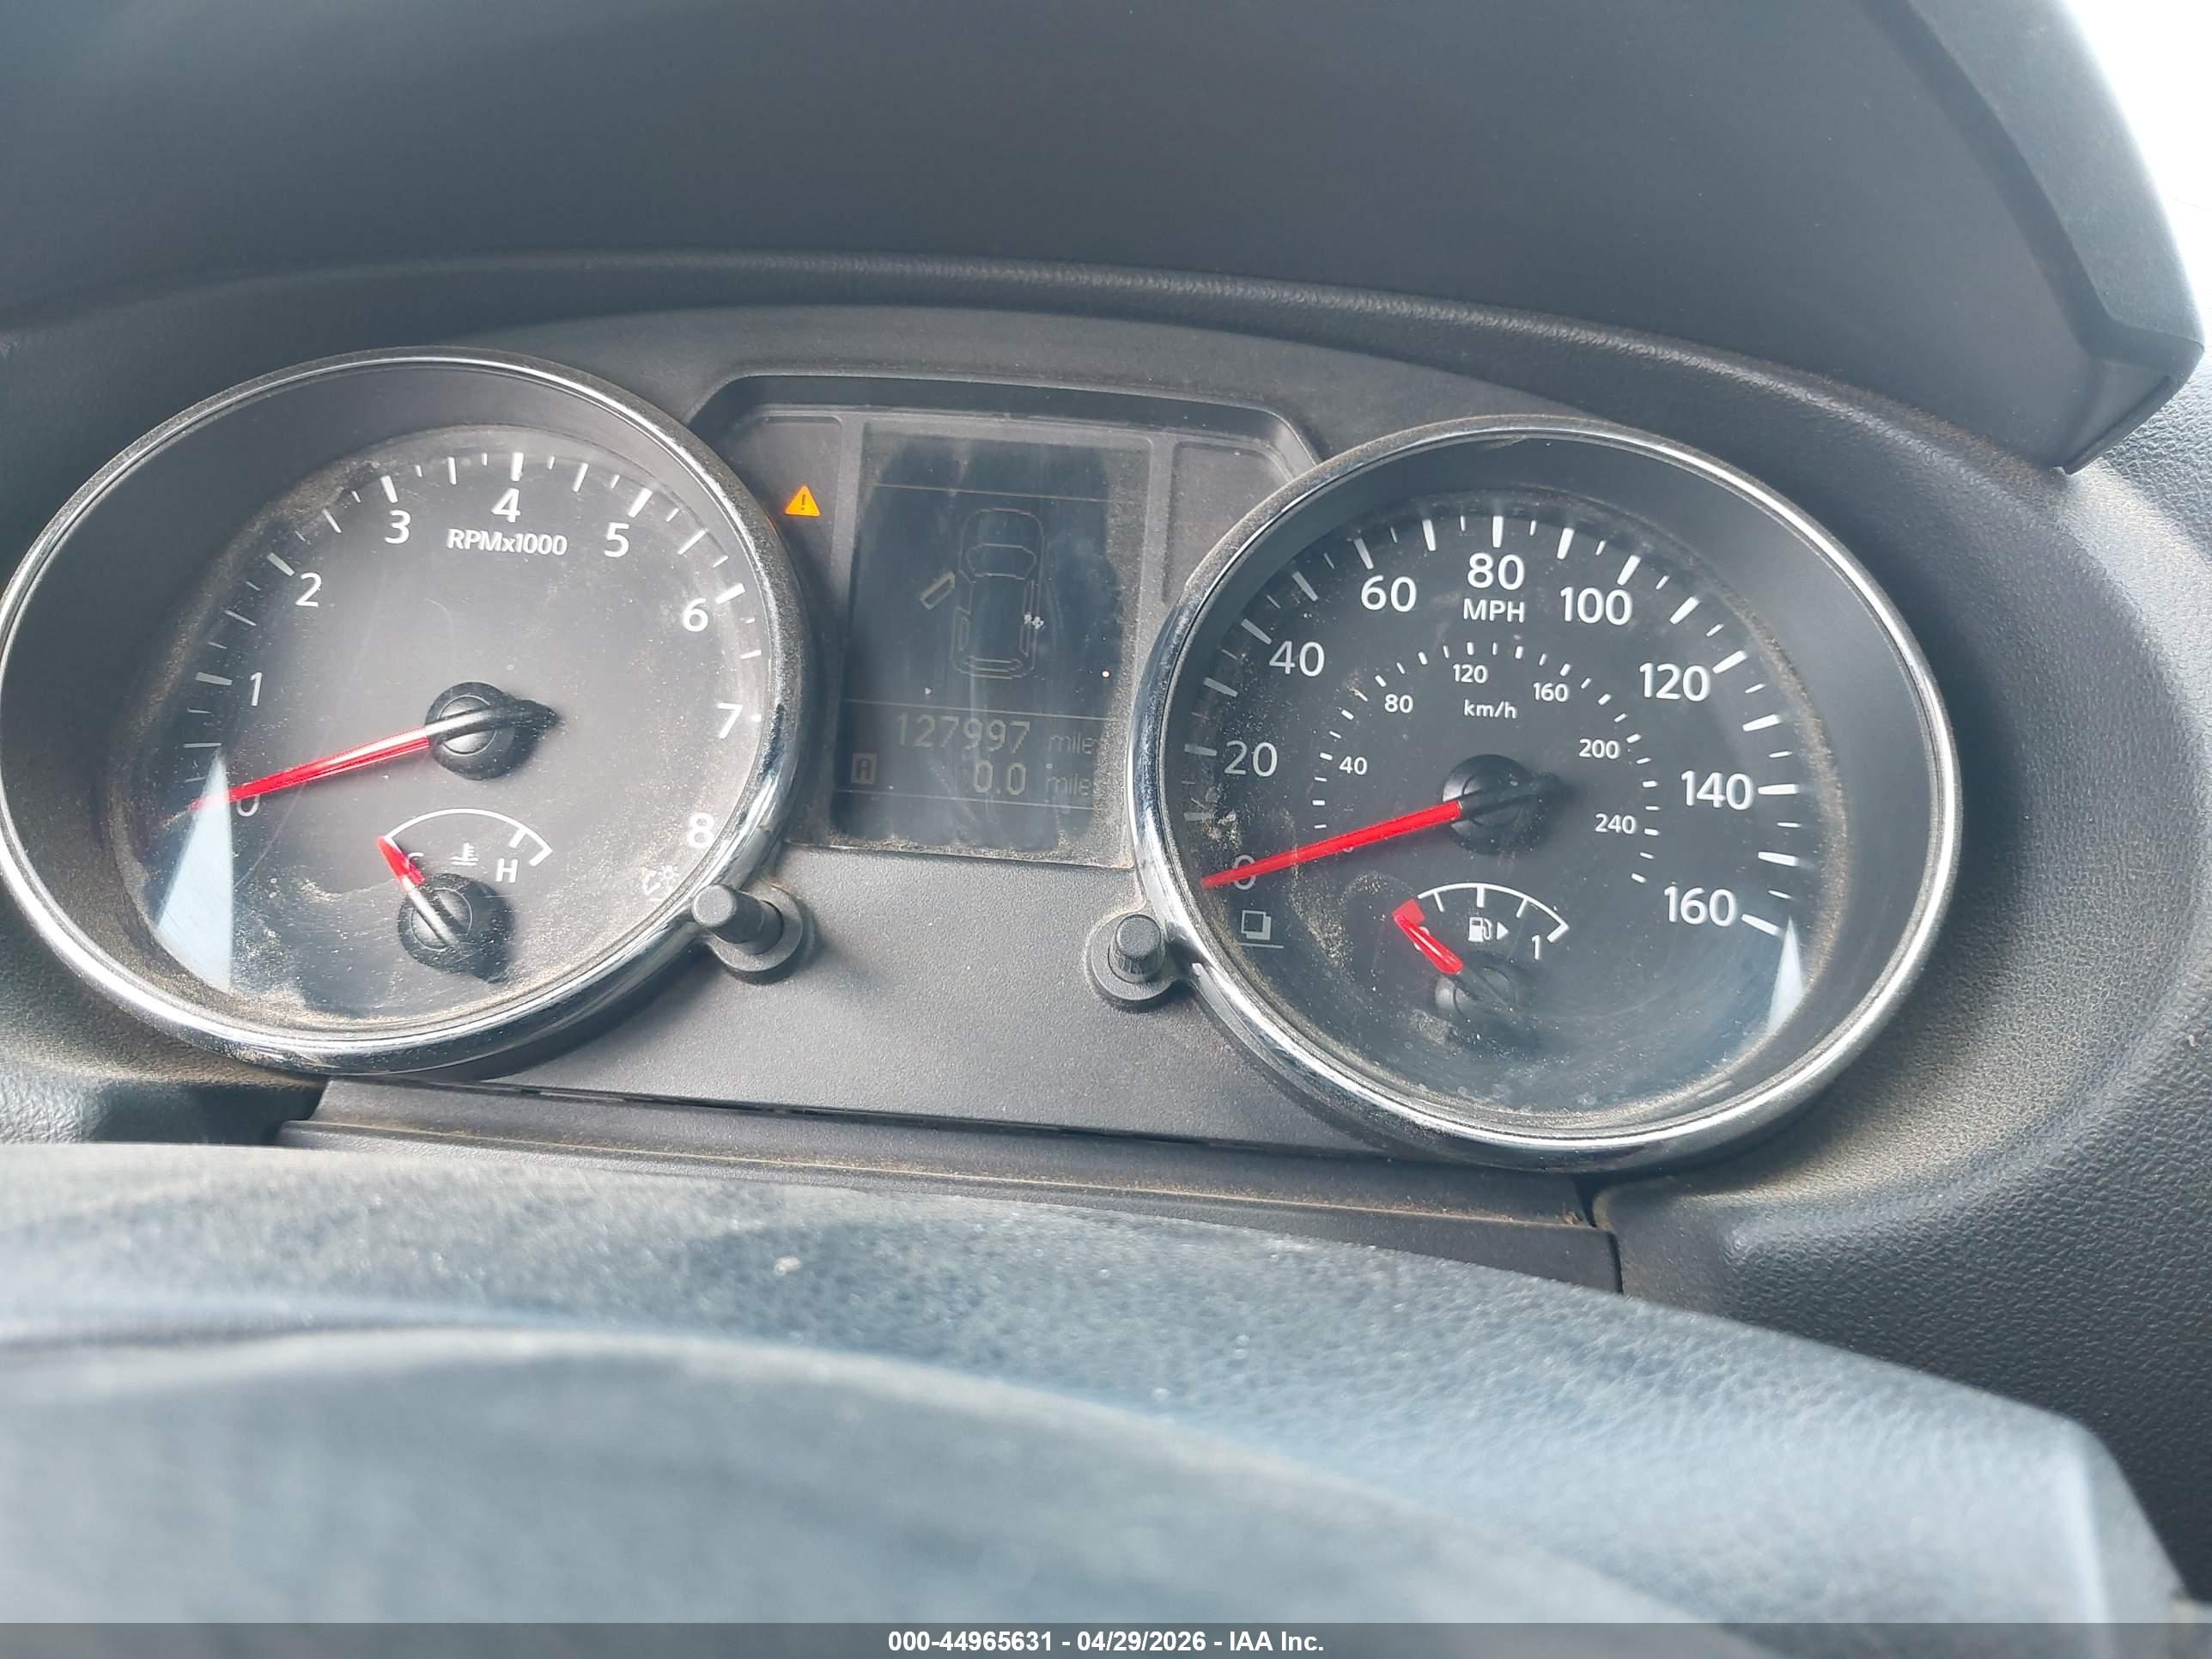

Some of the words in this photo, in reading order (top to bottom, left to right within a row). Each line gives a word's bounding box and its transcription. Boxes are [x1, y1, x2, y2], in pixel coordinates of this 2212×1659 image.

[492, 488, 520, 523] 4
[385, 510, 411, 544] 3
[447, 528, 568, 556] RPMx1000
[604, 522, 629, 557] 5
[1468, 552, 1524, 591] 80
[295, 572, 321, 607] 2
[1361, 576, 1417, 612] 60
[1560, 587, 1632, 627] 100
[683, 598, 708, 632] 6
[1463, 598, 1525, 623] MPH
[1268, 641, 1324, 677] 40
[1453, 664, 1487, 684] 120
[251, 672, 263, 706] 1
[1533, 682, 1569, 702] 160
[1639, 663, 1710, 701] 120
[717, 703, 743, 738] 7
[1384, 694, 1413, 714] 80
[1464, 699, 1516, 720] km/h
[894, 713, 1030, 753] 127997
[1579, 739, 1620, 759] 200
[1225, 741, 1278, 777] 20
[1340, 757, 1368, 775] 40
[1681, 771, 1753, 810] 140
[689, 813, 715, 848] 8
[1595, 813, 1636, 835] 240
[495, 858, 519, 883] H
[1232, 854, 1256, 890] 0
[1664, 886, 1735, 926] 160
[1532, 934, 1541, 960] 1
